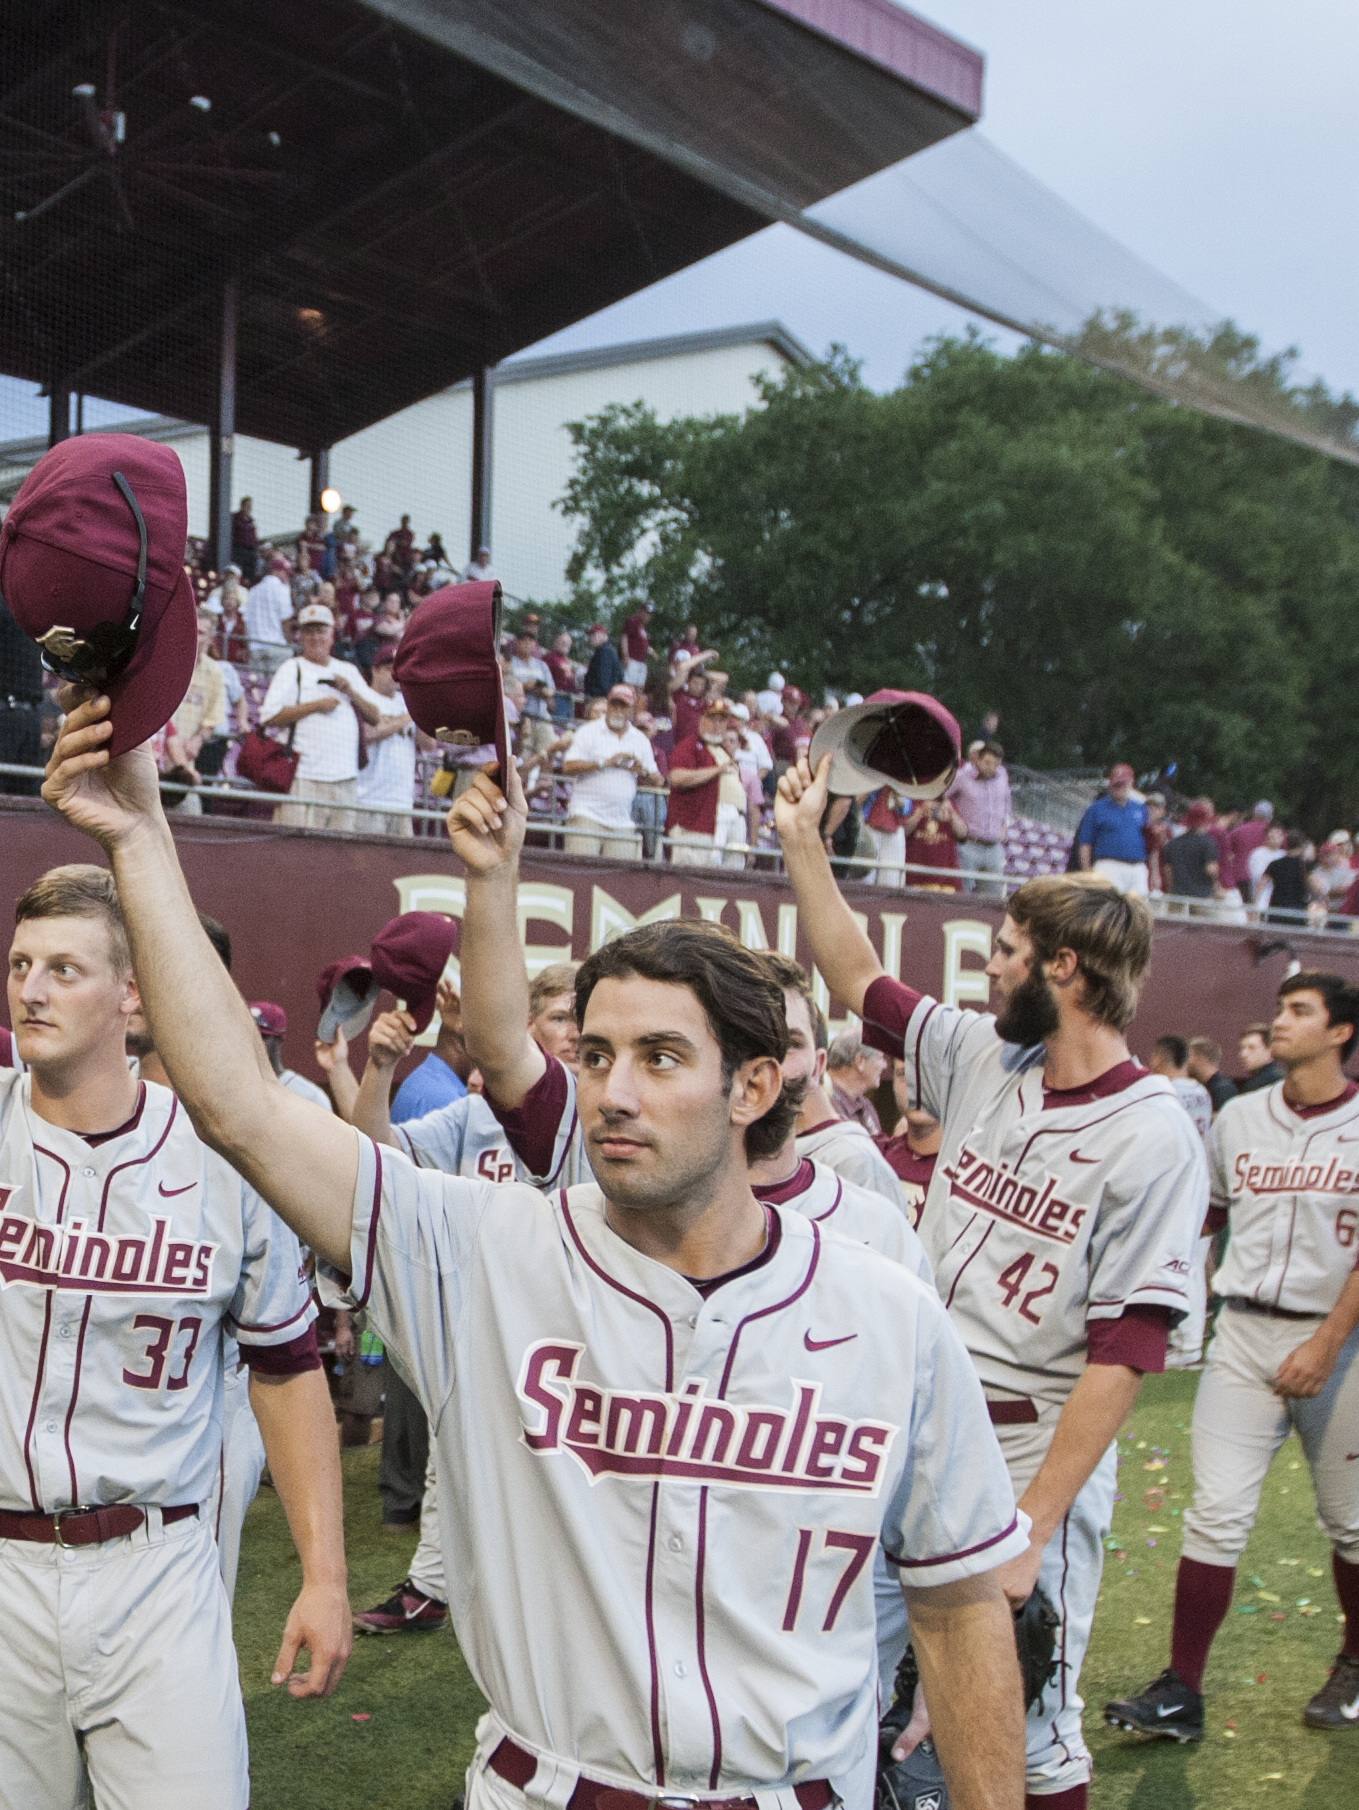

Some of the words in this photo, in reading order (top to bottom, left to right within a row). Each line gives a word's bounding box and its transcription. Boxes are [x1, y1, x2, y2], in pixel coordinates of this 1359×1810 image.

[940, 1132, 1091, 1247] eminoles
[996, 1251, 1060, 1327] 42
[121, 1313, 203, 1392] 33
[516, 1338, 901, 1494] Seminoles
[779, 1525, 877, 1635] 17
